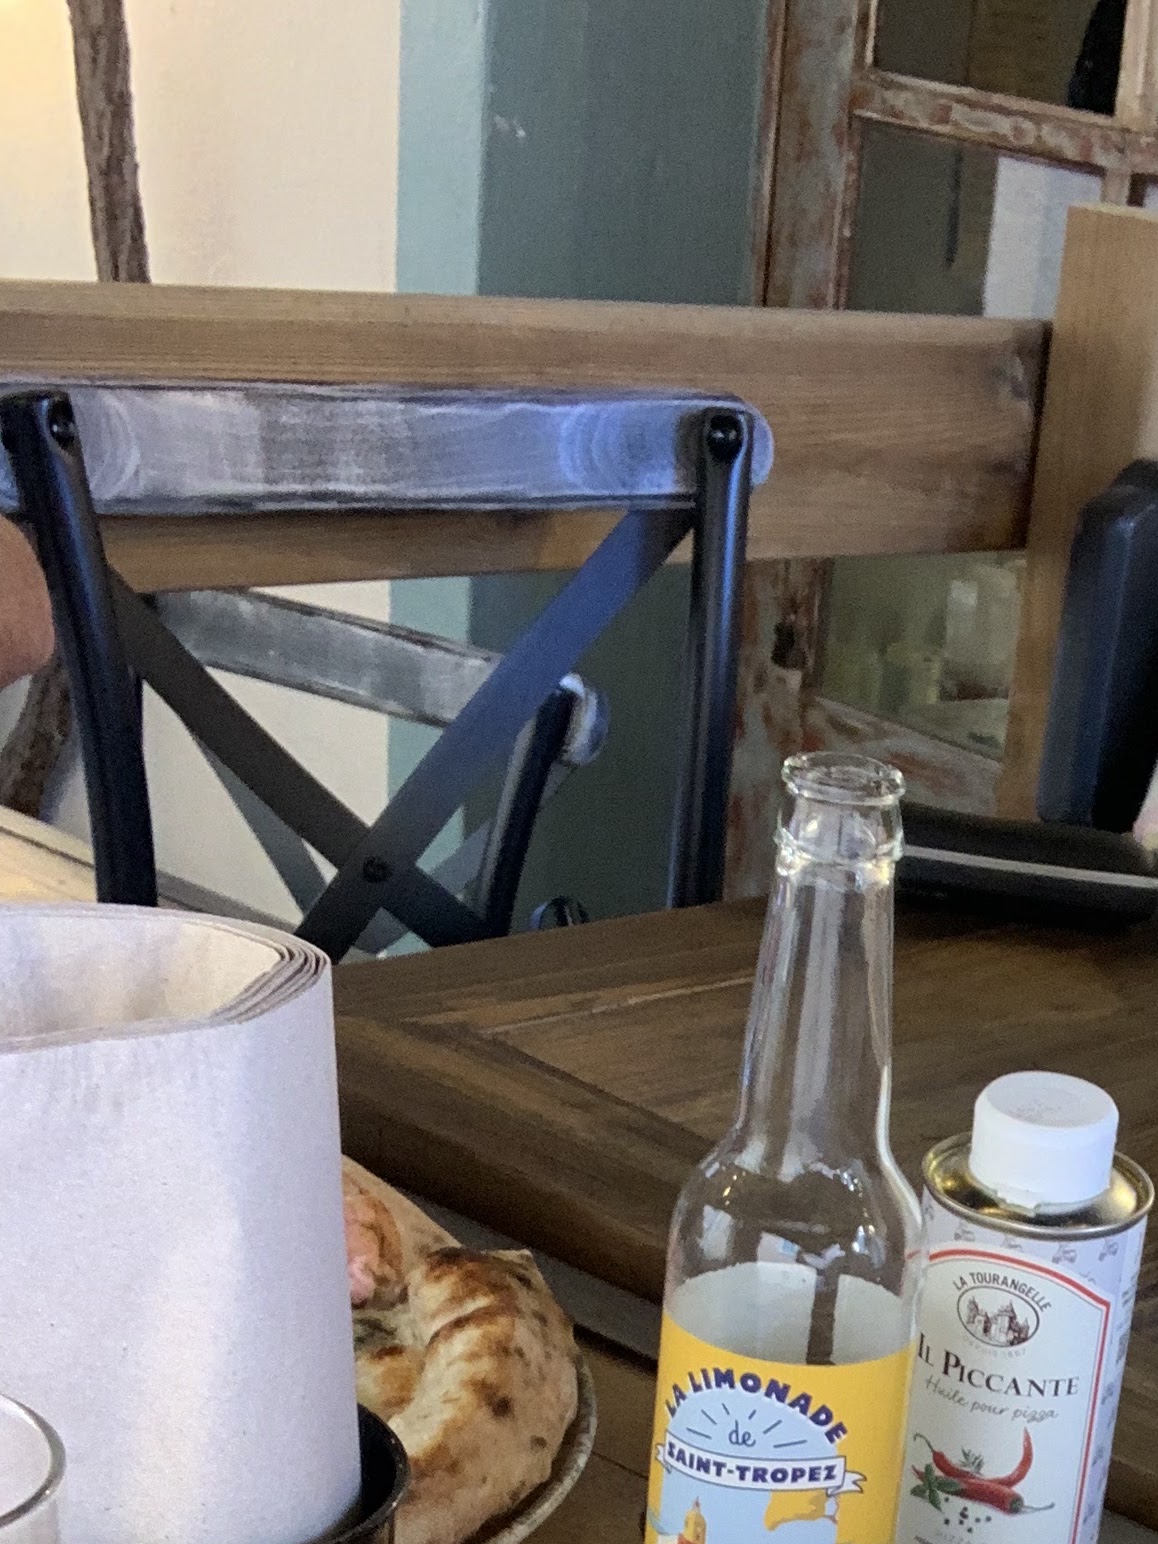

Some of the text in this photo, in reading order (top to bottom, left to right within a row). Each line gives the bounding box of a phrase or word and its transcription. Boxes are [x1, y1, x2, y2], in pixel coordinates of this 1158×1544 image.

[952, 1271, 1053, 1313] LA TOURANGELLE
[941, 1348, 1081, 1398] PICCANTE
[665, 1366, 849, 1445] LA LIMONADE
[924, 1374, 1061, 1425] Huile pour pizza
[728, 1419, 757, 1448] de
[666, 1440, 839, 1485] SAINT-TROPEZ
